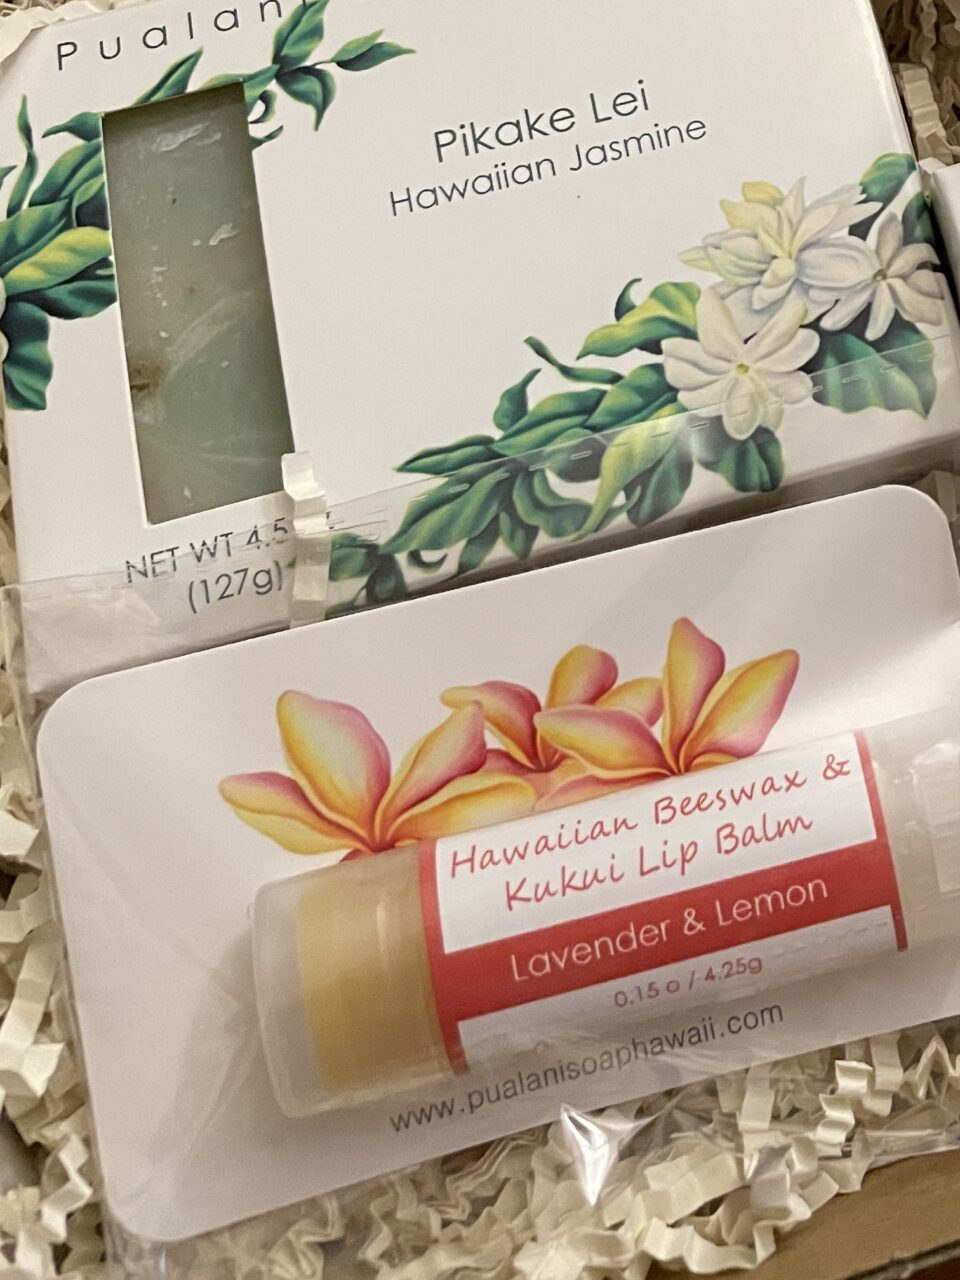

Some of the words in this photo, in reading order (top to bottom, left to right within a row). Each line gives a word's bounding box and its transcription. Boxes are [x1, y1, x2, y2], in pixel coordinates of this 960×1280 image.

[389, 156, 557, 217] Hawaiian
[567, 114, 708, 174] Jasmine
[432, 105, 576, 163] Pikake
[588, 79, 650, 123] Lei
[125, 546, 180, 583] NET
[190, 531, 234, 564] WT
[187, 560, 284, 614] (127g)
[449, 812, 639, 879] Hawaiian
[653, 765, 808, 826] Beeswax
[822, 753, 852, 780] &
[505, 854, 626, 911] Kukui
[637, 840, 700, 877] Lip
[714, 811, 814, 856] Balm
[509, 920, 673, 983] Lavender
[681, 908, 707, 937] &
[714, 874, 830, 926] Lemon
[613, 980, 662, 1009] 0.15
[703, 953, 764, 983] 4.25g
[389, 1000, 785, 1134] www.pualanisoaphawaii.com
